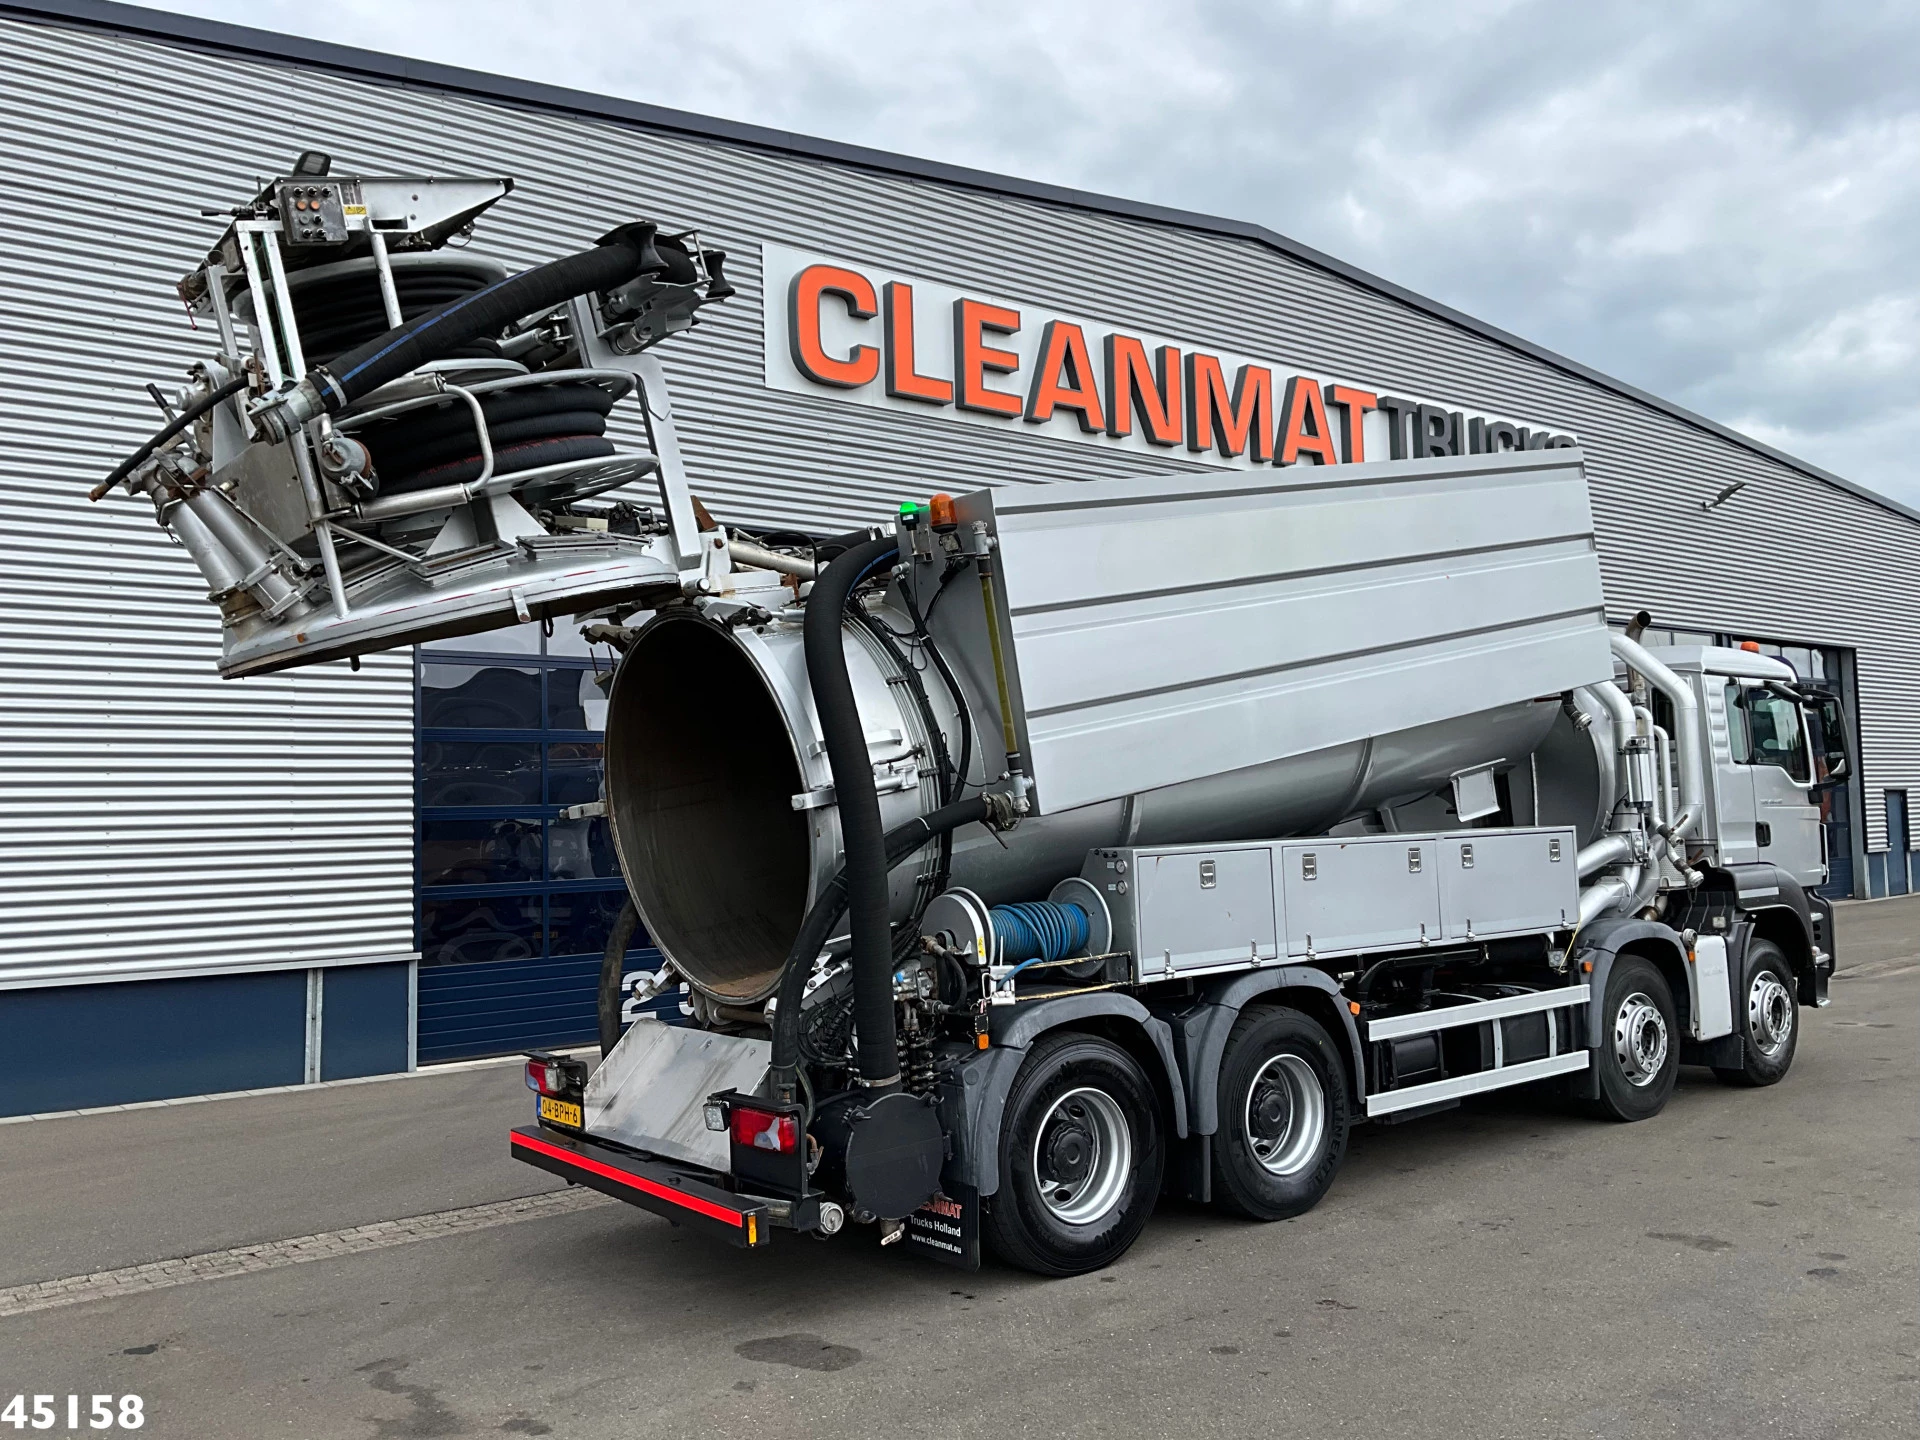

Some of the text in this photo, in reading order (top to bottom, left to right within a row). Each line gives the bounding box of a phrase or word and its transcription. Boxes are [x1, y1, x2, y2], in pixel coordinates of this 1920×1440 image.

[788, 264, 1377, 465] CLEANMAT
[543, 1099, 578, 1123] 04-BPH-6
[910, 1214, 961, 1237] Trucks Holland
[911, 1233, 962, 1254] www.cleanmat.eu
